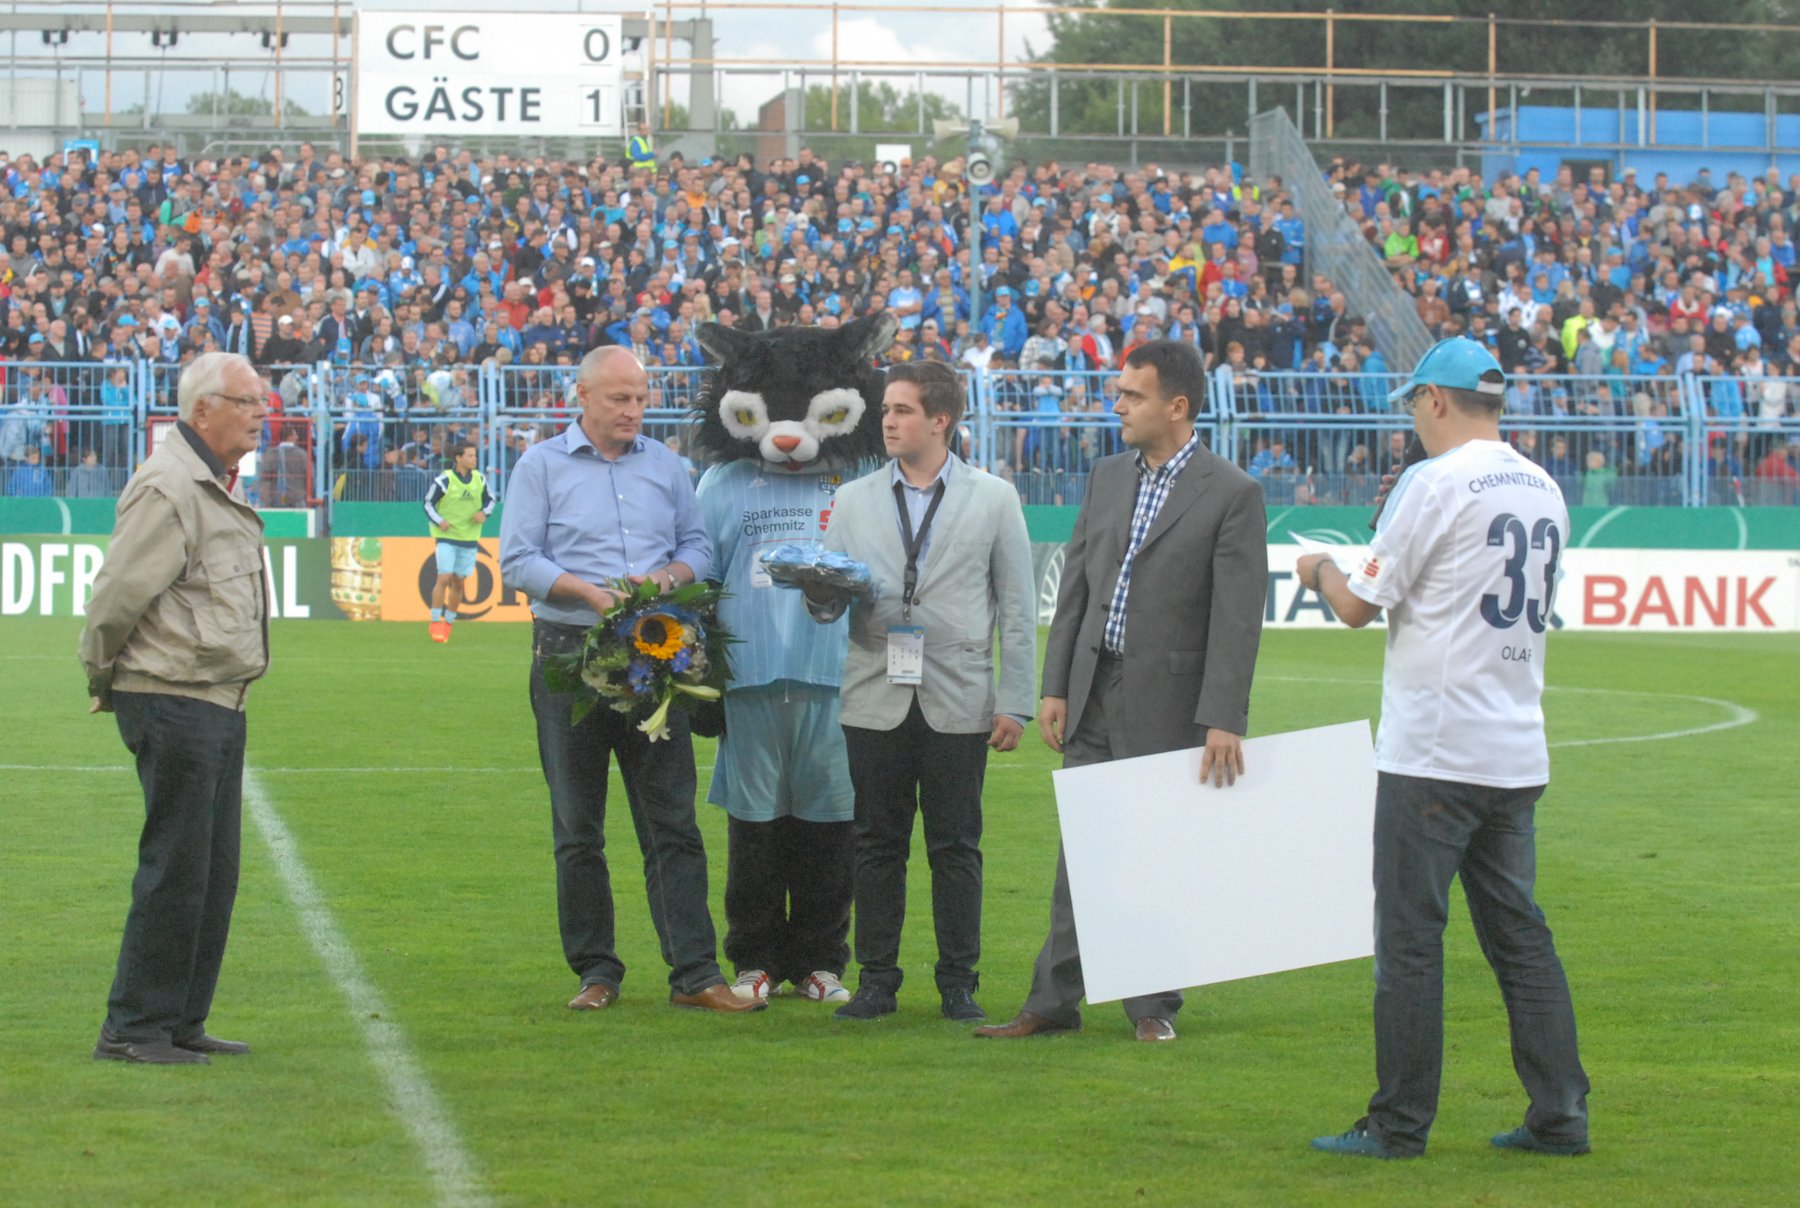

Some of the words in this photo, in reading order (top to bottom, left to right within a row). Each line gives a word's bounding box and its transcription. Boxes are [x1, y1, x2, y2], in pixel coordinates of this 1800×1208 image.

[385, 24, 480, 61] CFC
[583, 28, 610, 62] 0
[385, 76, 541, 122] GÄSTE
[586, 89, 600, 122] 1
[1468, 472, 1548, 494] CHEMNITZER
[742, 507, 813, 523] Sparkasse
[744, 520, 805, 537] Chemnitz
[1480, 512, 1560, 634] 33
[1583, 574, 1777, 627] BANK
